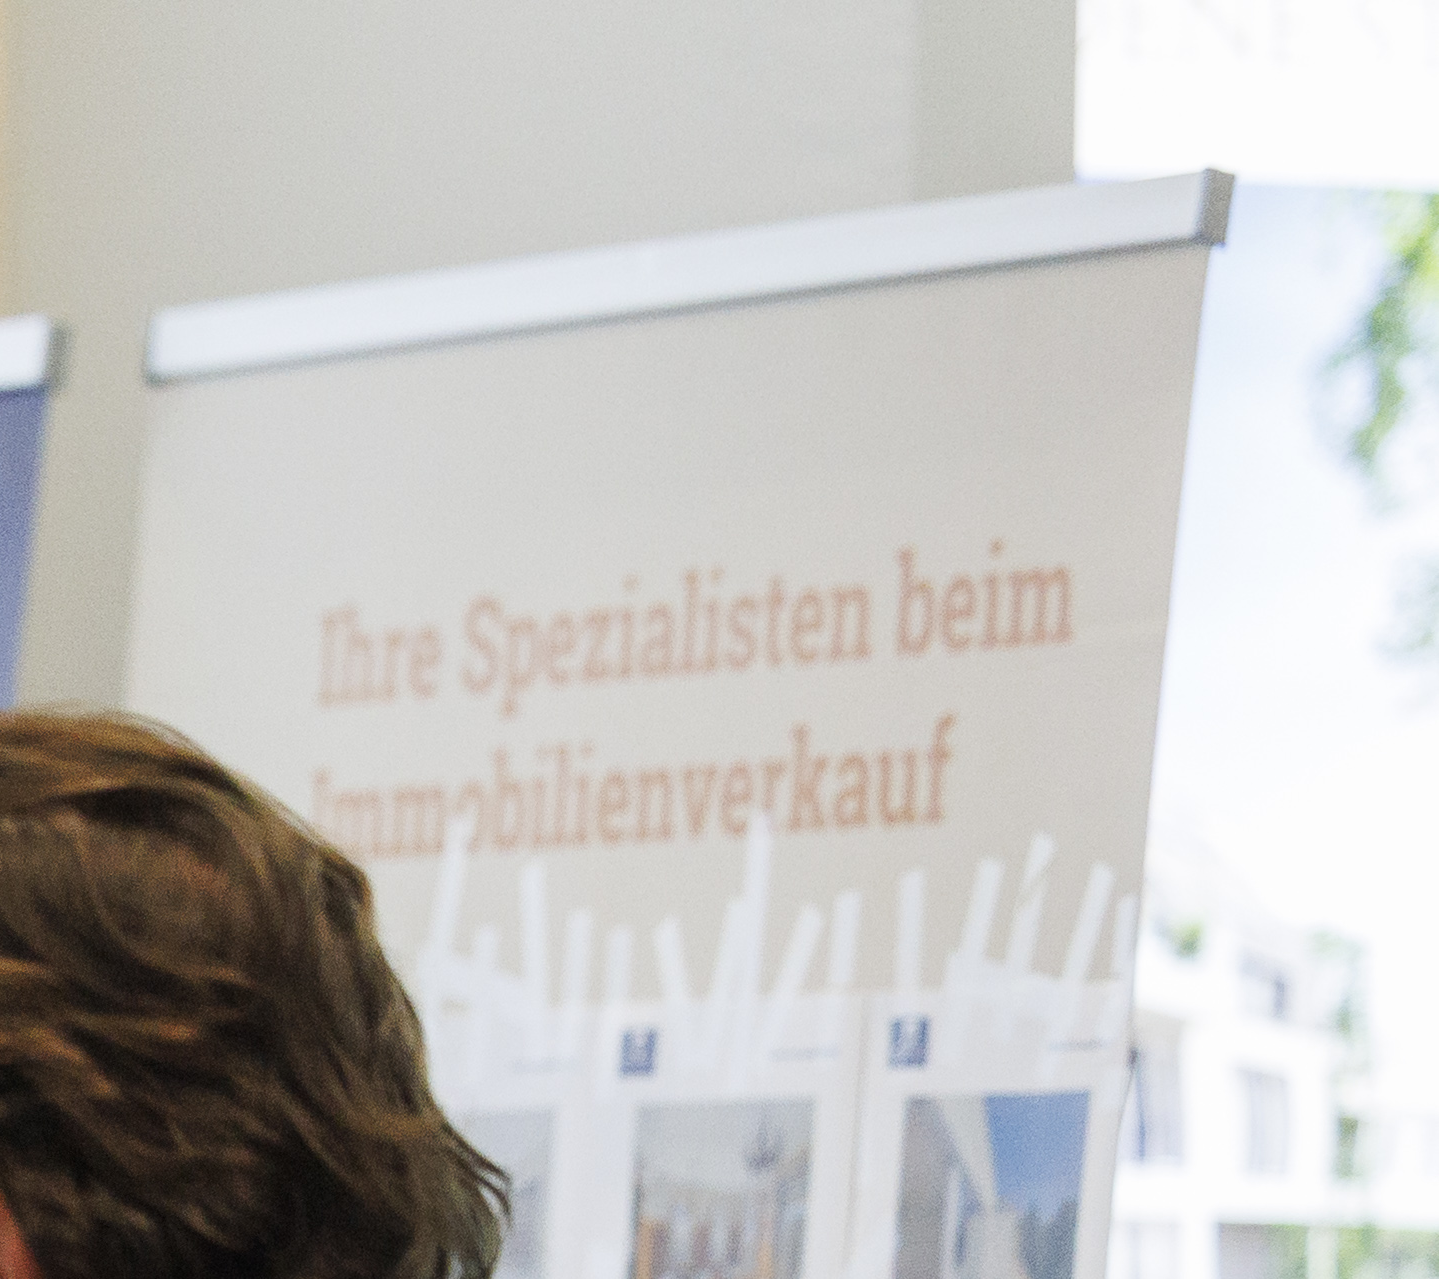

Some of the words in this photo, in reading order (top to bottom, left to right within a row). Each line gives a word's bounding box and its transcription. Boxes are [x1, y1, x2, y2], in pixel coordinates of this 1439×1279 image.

[316, 604, 443, 708] Ihre
[460, 568, 872, 718] Spezialisten
[896, 540, 1076, 657] beim
